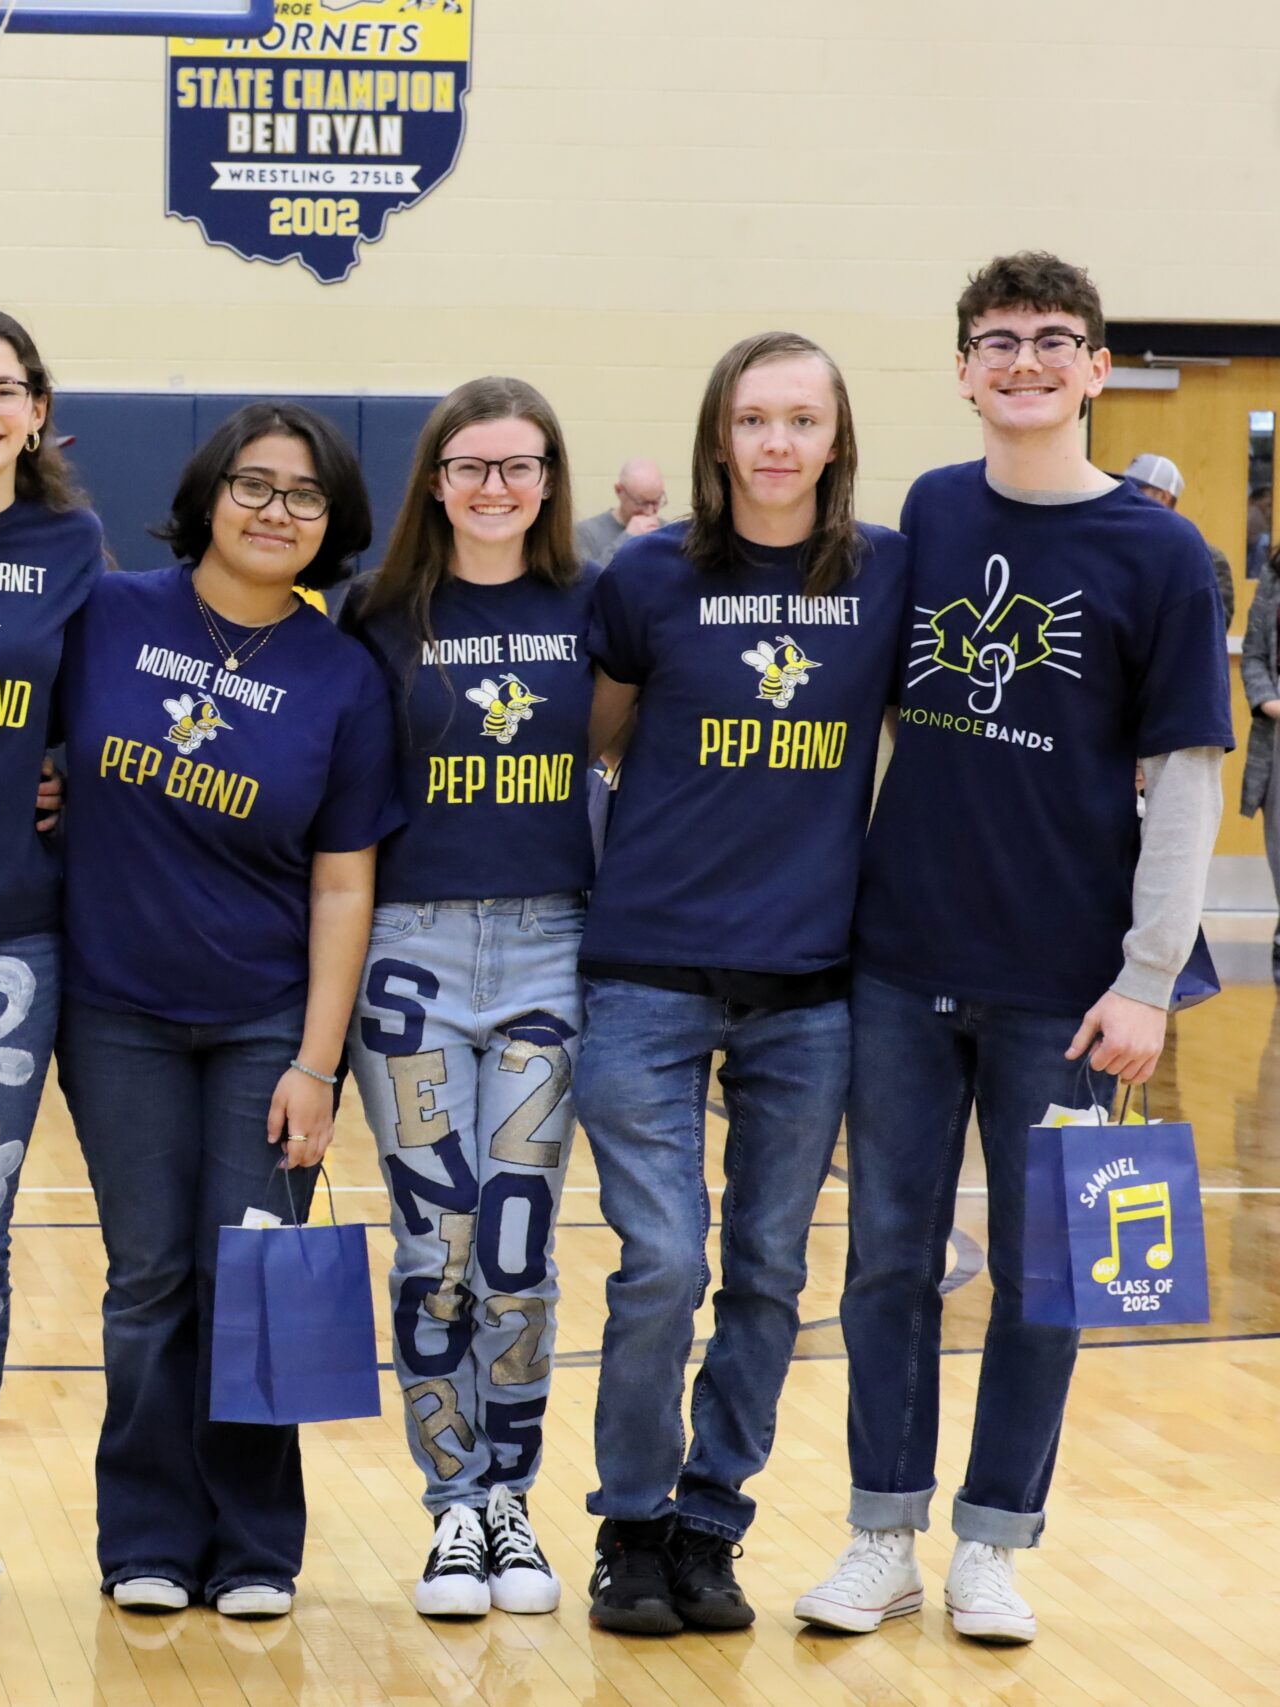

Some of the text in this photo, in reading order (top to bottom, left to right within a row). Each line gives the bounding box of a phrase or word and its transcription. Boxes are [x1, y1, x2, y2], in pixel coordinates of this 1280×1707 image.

[177, 67, 455, 112] STATE CHAMPION
[228, 112, 402, 155] BEN RYAN
[228, 168, 405, 185] WRESTLING 275LB
[270, 198, 359, 236] 2002
[700, 594, 860, 626] MONROE HORNET
[422, 633, 577, 666] MONROE HORNET
[135, 644, 287, 714] MONROE HORNET
[699, 718, 848, 770] PEP BAND
[100, 735, 259, 819] PEP BAND
[427, 753, 574, 804] PEP BAND
[1080, 1157, 1139, 1209] SAMUEL
[1107, 1279, 1173, 1295] CLASS OF
[1122, 1295, 1160, 1312] 2025
